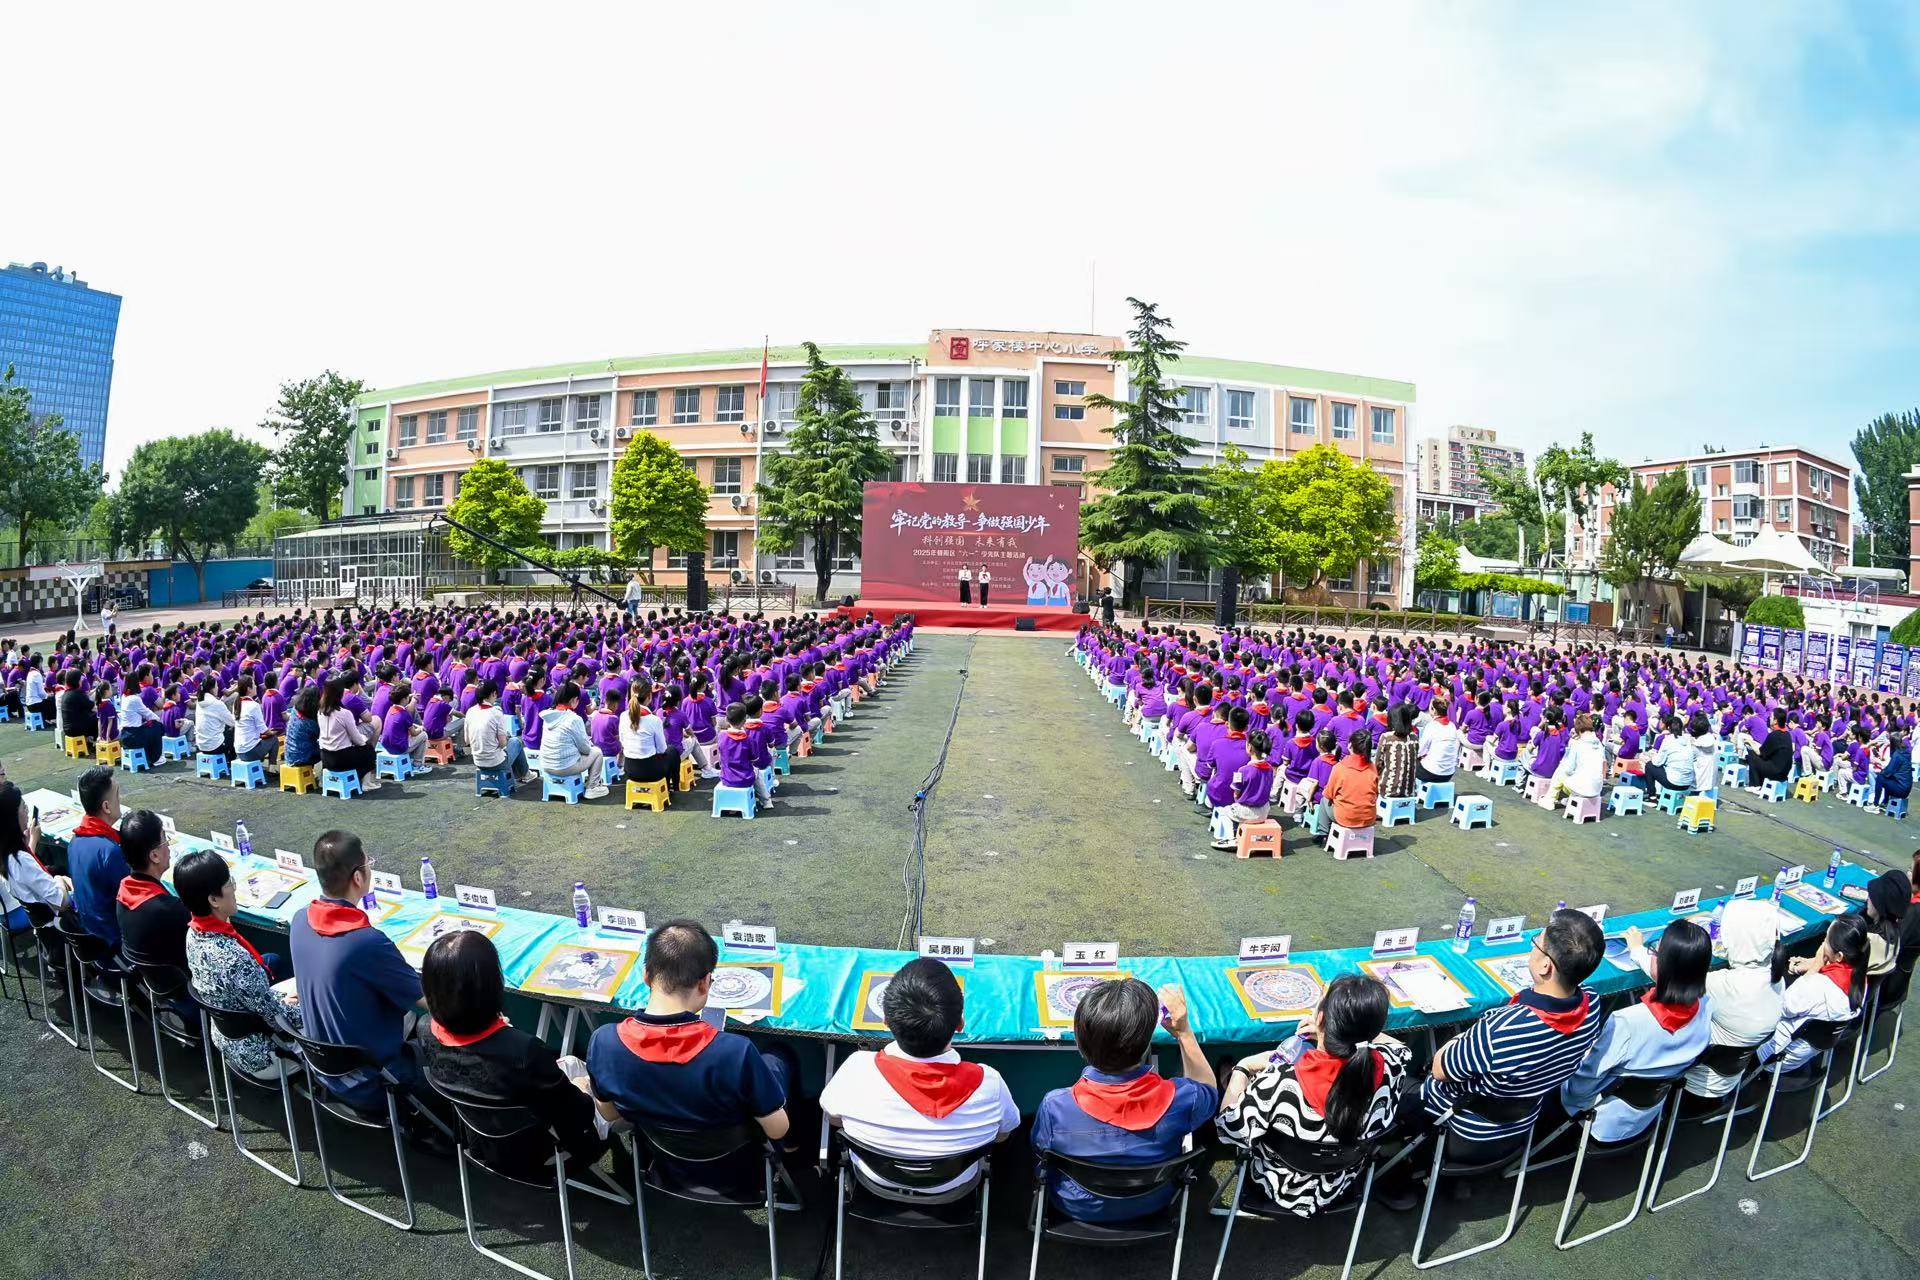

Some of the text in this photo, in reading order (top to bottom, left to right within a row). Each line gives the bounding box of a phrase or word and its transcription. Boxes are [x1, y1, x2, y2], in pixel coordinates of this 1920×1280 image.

[973, 338, 1099, 357] 呼家楼中心小学
[889, 509, 1050, 537] 牢记党的教导 争做强国少年
[922, 535, 1018, 549] 科创强国 未来有我
[928, 944, 965, 955] 吴勇刚
